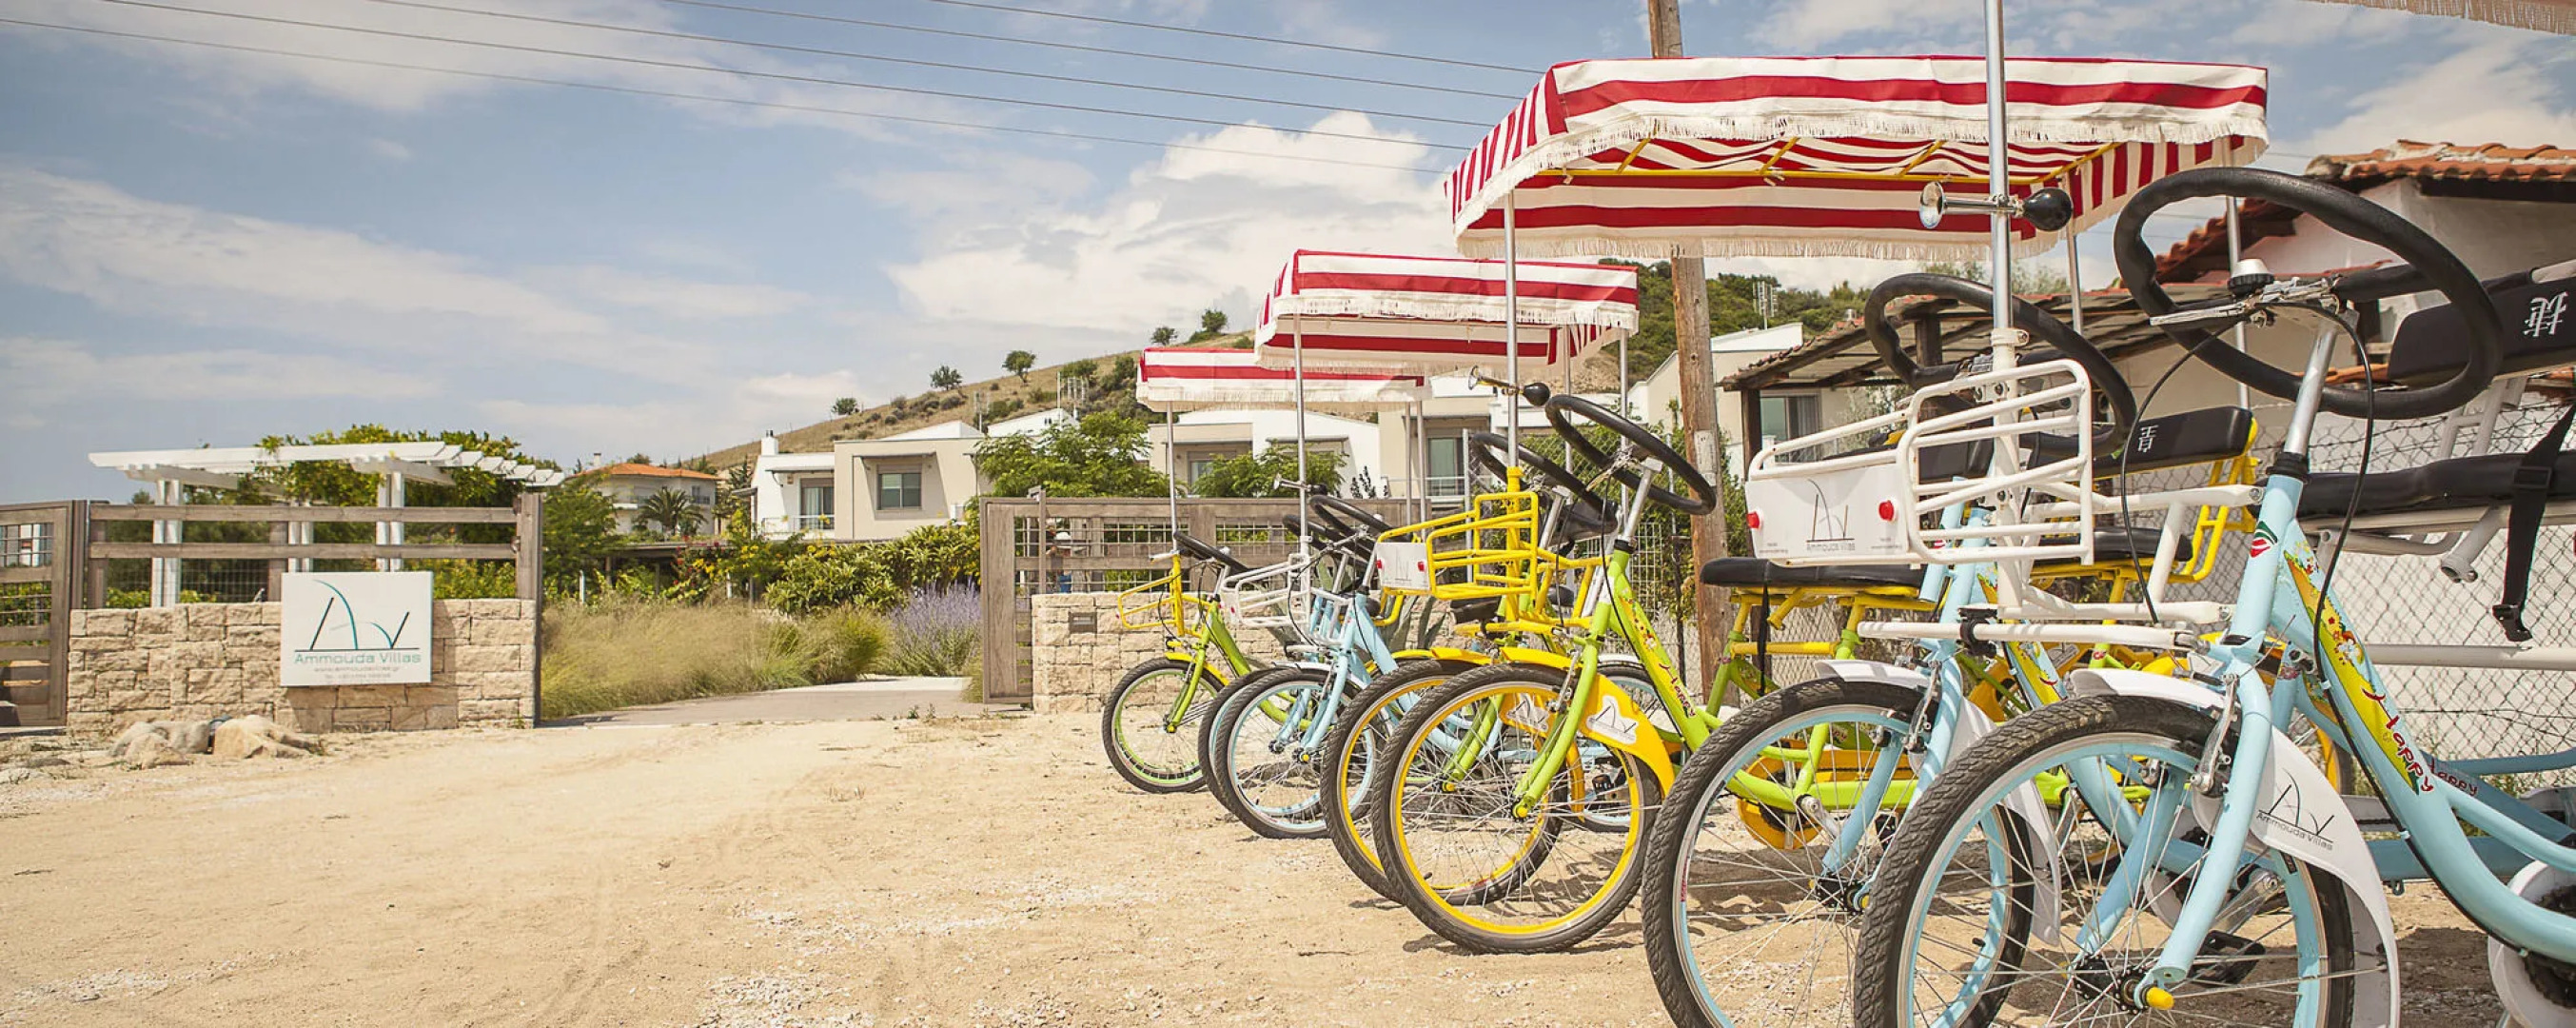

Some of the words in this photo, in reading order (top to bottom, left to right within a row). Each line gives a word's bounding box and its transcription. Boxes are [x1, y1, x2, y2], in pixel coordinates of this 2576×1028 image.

[294, 653, 376, 664] Ammouda
[380, 652, 422, 664] Villas
[2362, 688, 2434, 793] Happy
[2256, 812, 2305, 839] Ammouda
[2307, 833, 2333, 852] Villas
